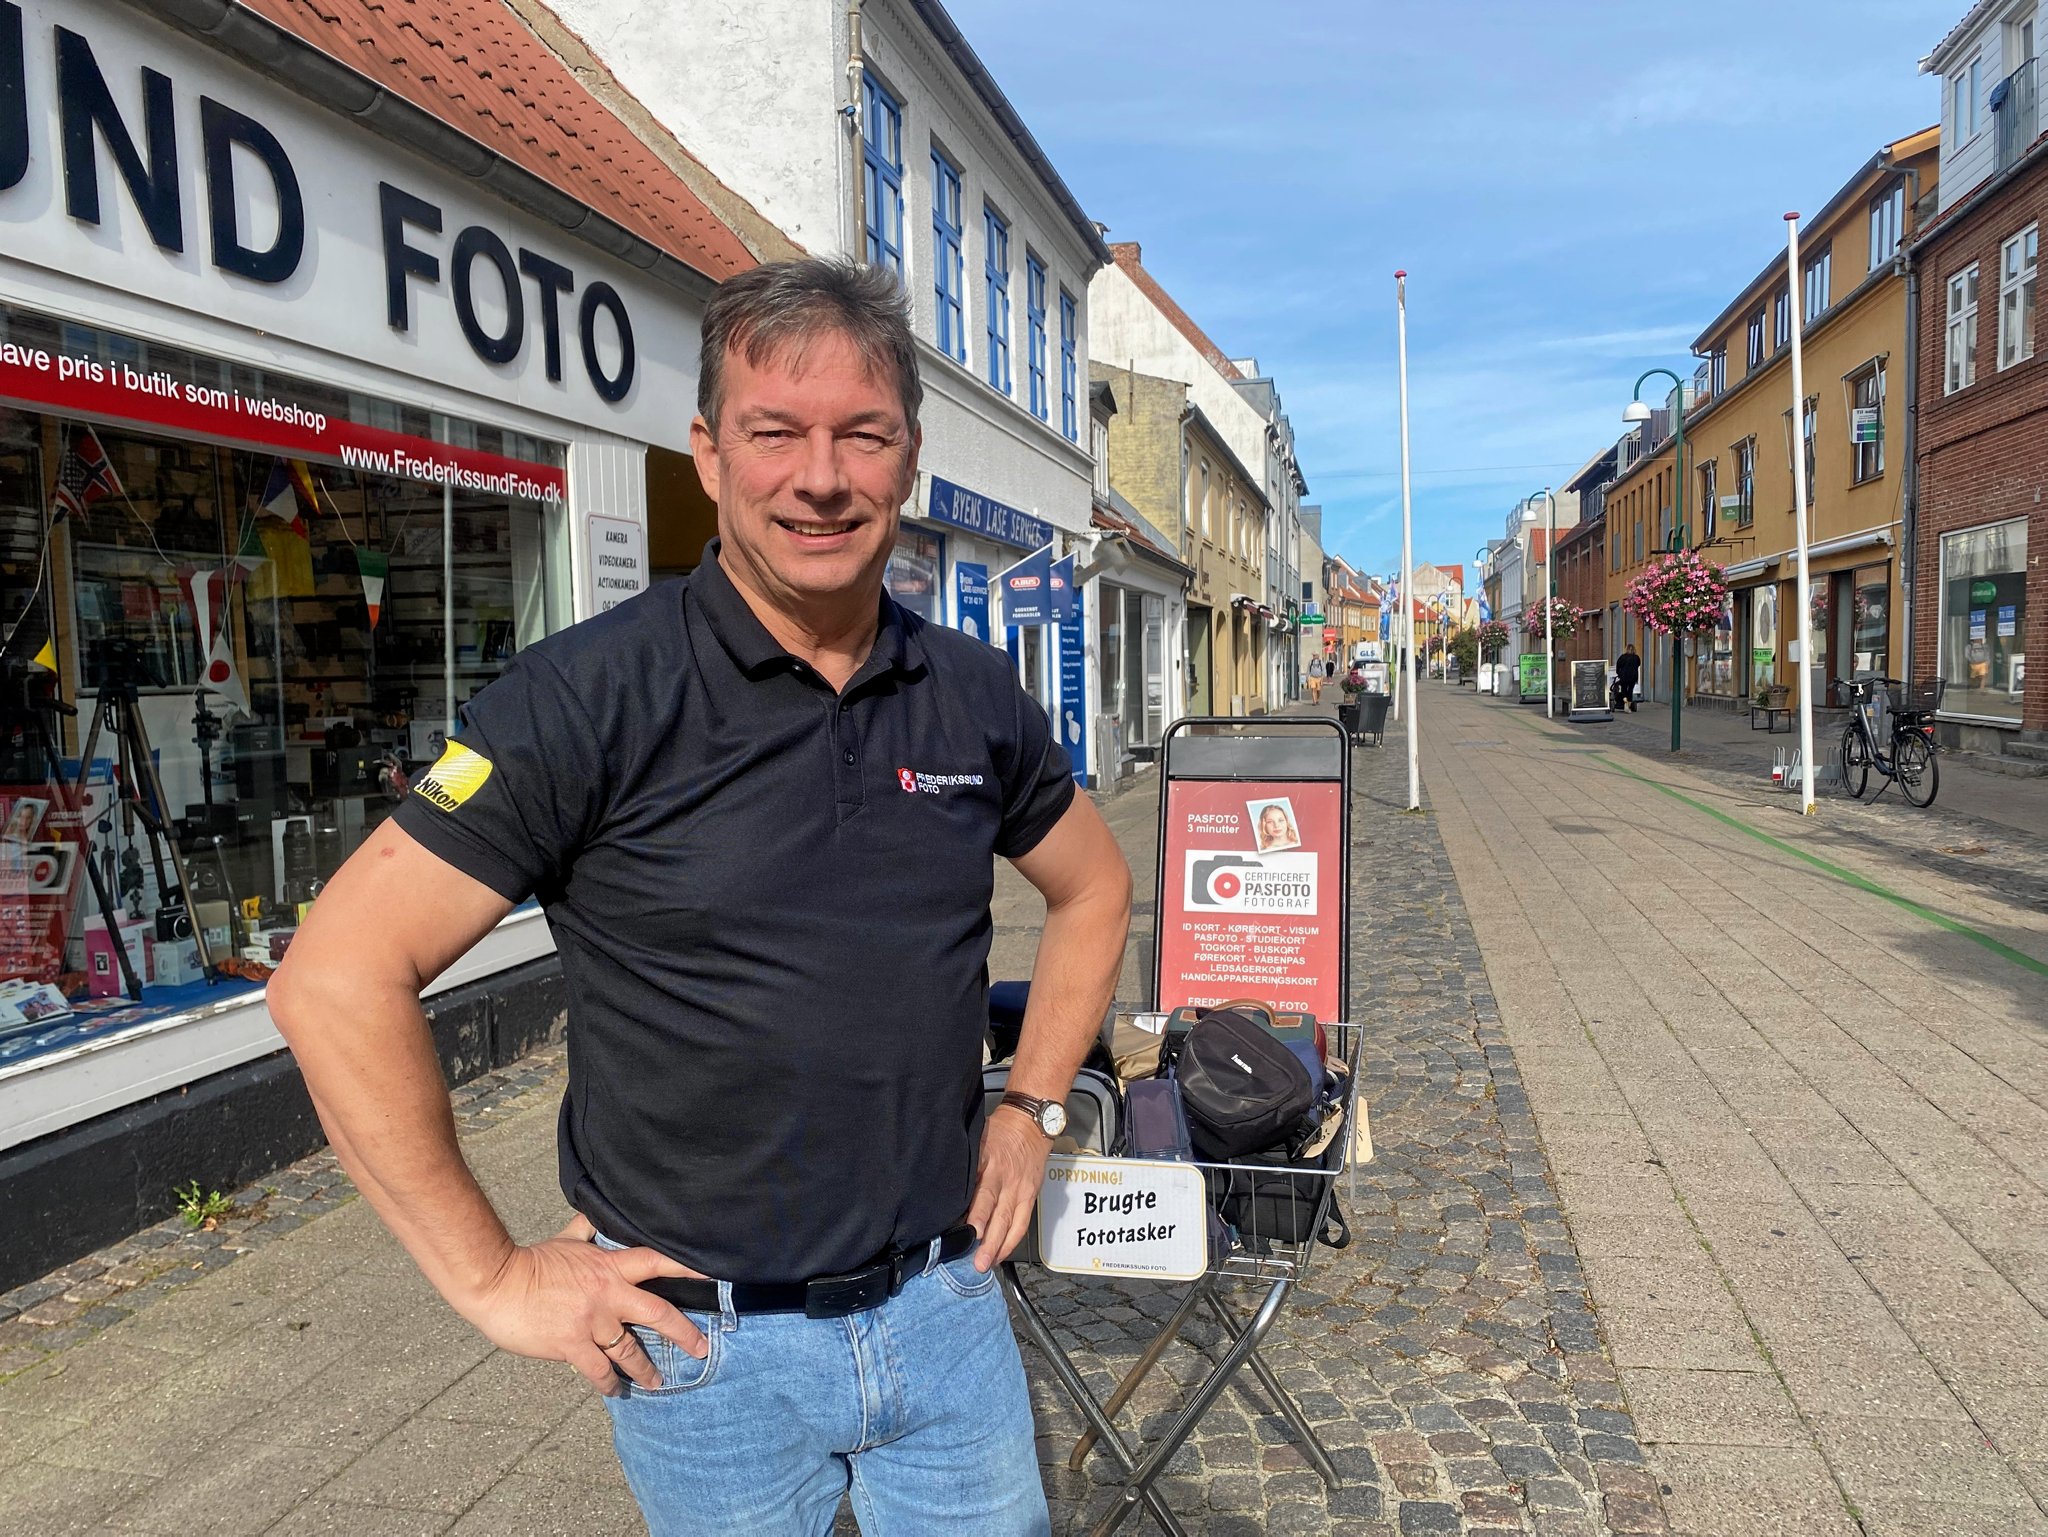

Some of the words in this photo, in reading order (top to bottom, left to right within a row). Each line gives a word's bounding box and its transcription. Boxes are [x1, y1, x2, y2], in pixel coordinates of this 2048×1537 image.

[0, 0, 303, 282] ND
[379, 181, 635, 402] FOTO
[0, 341, 50, 371] ave
[58, 354, 104, 382] pris
[111, 361, 117, 386] i
[124, 363, 179, 399] butik
[185, 386, 229, 410] som
[234, 389, 240, 412] i
[245, 397, 327, 434] webshop
[340, 444, 562, 505] www.FrederikssundFoto.dk
[952, 489, 982, 528] BYENS
[986, 503, 1008, 537] LÅSE
[1011, 512, 1041, 548] SERVICE
[605, 530, 628, 544] KAMERA
[598, 554, 637, 569] VIDEOKAMERA
[598, 576, 639, 591] ACTIONKAMERA
[916, 772, 983, 785] FREDERIKSSUND
[417, 777, 459, 810] Nikon
[917, 782, 940, 794] FOTO
[1188, 814, 1239, 824] PASFOTO
[1187, 824, 1194, 832] 3
[1196, 824, 1240, 834] minutter
[1244, 872, 1310, 882] CERTIFICERET
[1245, 883, 1311, 897] PASFOTO
[1244, 898, 1310, 908] FOTOGRAF
[1183, 923, 1192, 931] ID
[1194, 923, 1220, 932] KORT
[1228, 924, 1281, 934] KØREKORT
[1289, 926, 1319, 935] VISUM
[1194, 933, 1238, 943] PASFOTO
[1245, 935, 1307, 945] STUDIEKORT
[1200, 943, 1246, 953] TOGKORT
[1253, 945, 1300, 955] BUSKORT
[1194, 953, 1246, 963] FØREKORT
[1254, 955, 1306, 965] VÅBENPAS
[1210, 964, 1289, 974] LEDSAGERKORT
[1181, 973, 1319, 986] HANDICAPPARKERINGSKORT
[1279, 1001, 1309, 1011] FOTO
[1048, 1167, 1123, 1185] OPRYDNING!
[1084, 1190, 1157, 1215] Brugte
[1077, 1222, 1176, 1247] Fototasker
[1102, 1262, 1150, 1271] FREDERIKSSUND
